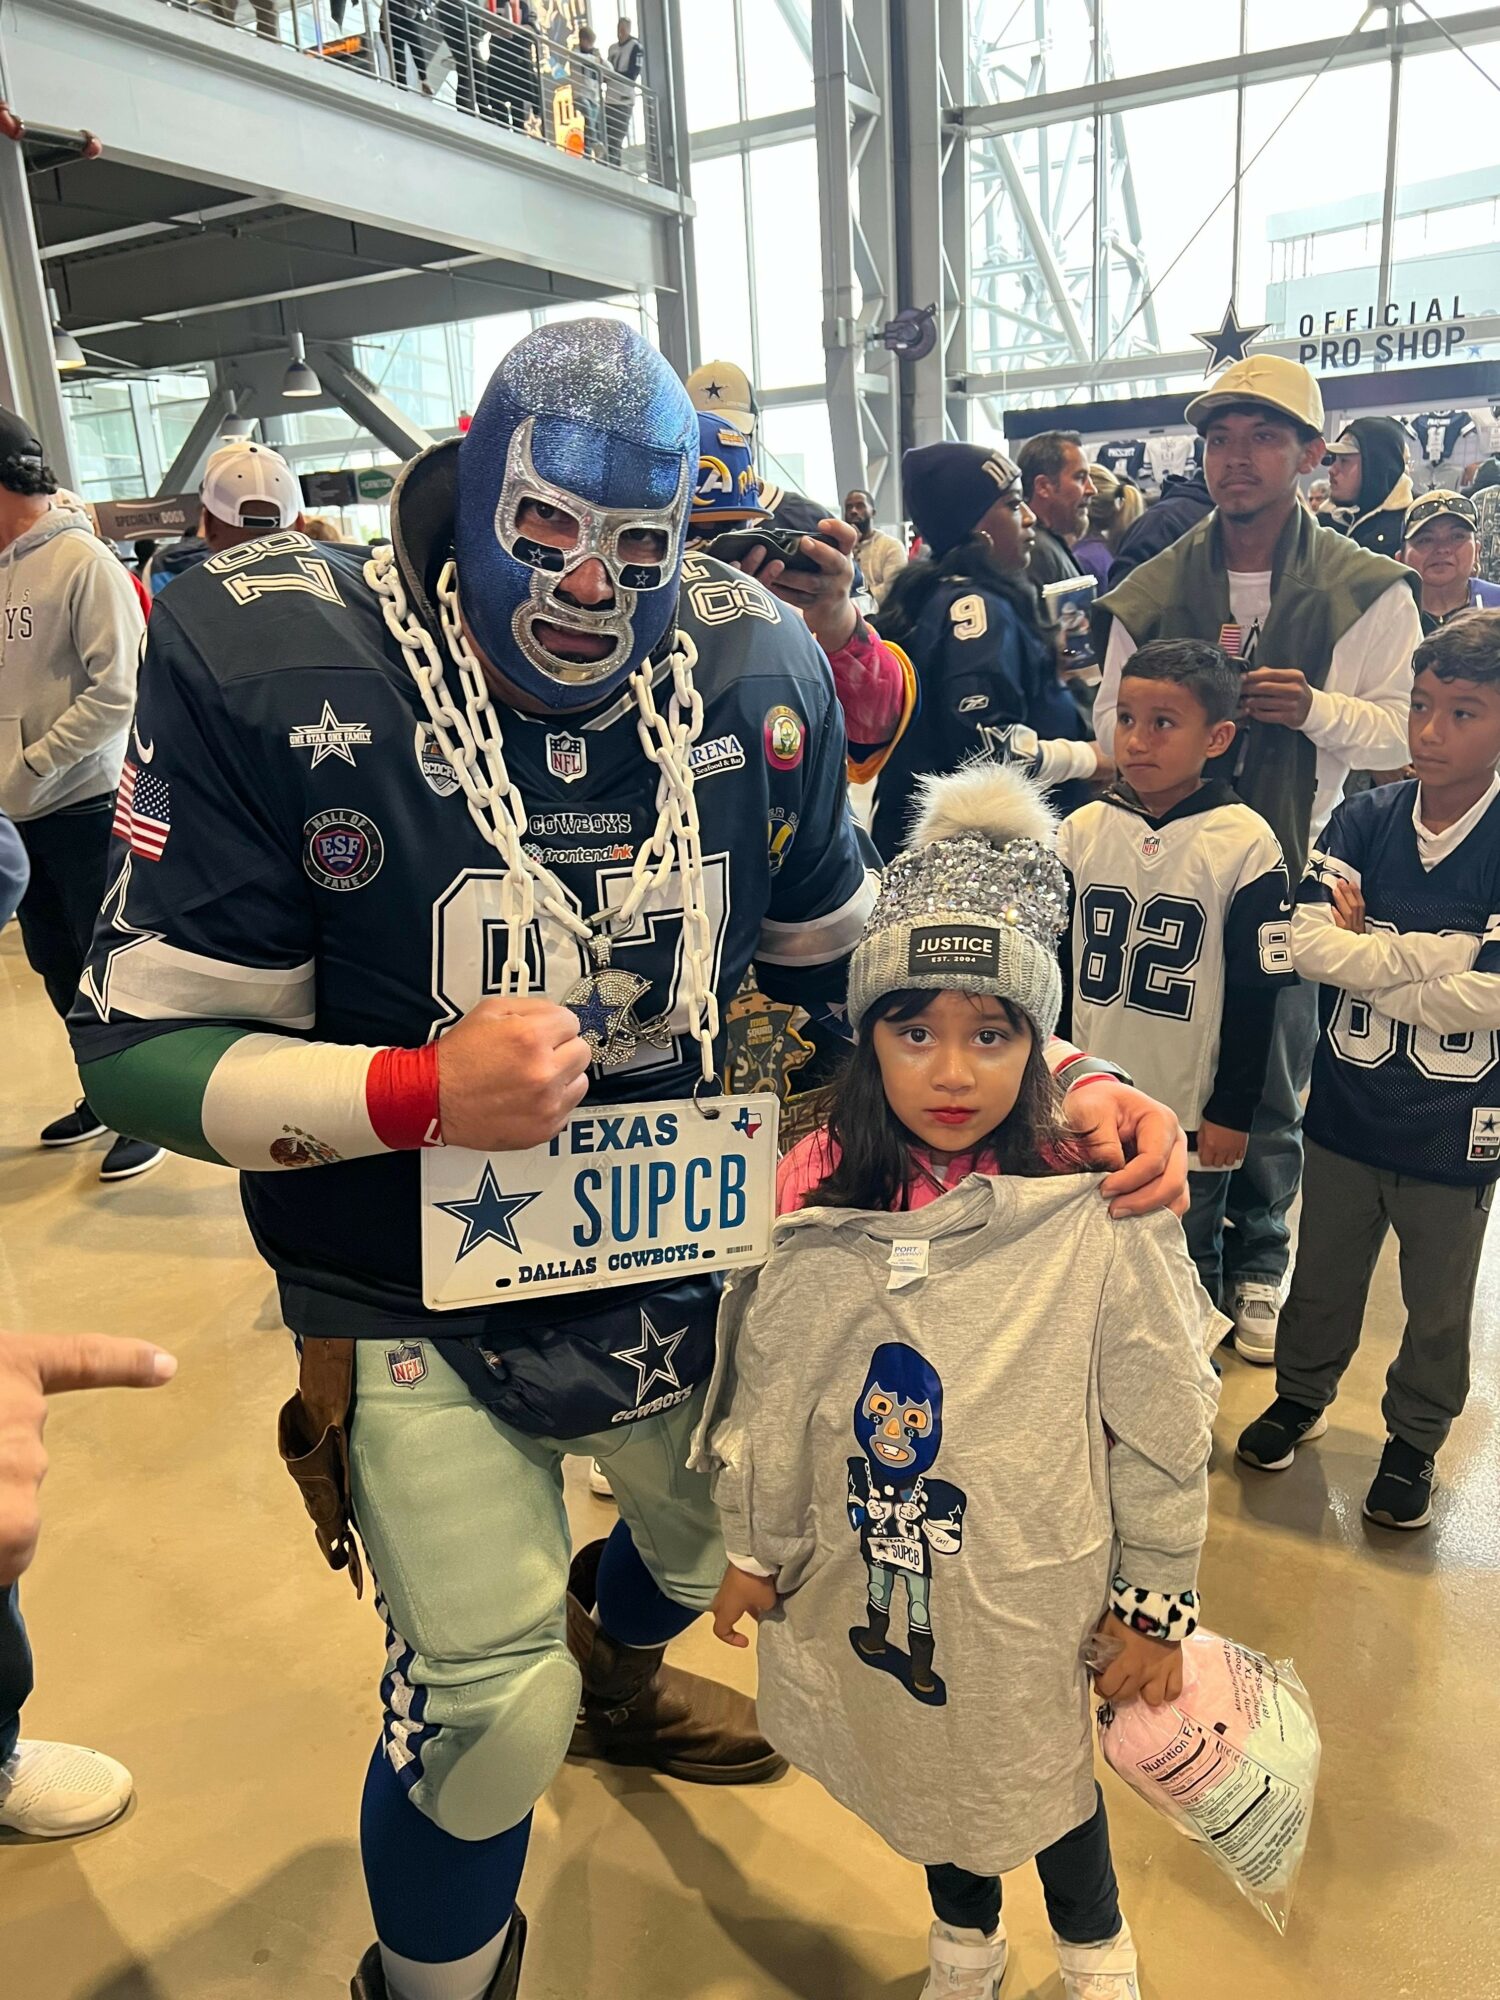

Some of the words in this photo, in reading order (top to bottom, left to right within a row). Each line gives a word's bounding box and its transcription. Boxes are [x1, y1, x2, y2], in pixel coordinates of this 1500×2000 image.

[1300, 295, 1466, 338] OFFICIAL
[1300, 338, 1361, 370] PRO
[1374, 326, 1465, 363] SHOP
[160, 509, 186, 524] DOGS
[950, 594, 988, 641] 9
[289, 735, 305, 745] ONE
[306, 733, 326, 744] STAR
[327, 732, 343, 742] ONE
[344, 731, 371, 742] FAMILY
[553, 752, 581, 774] NFL
[695, 760, 723, 775] Seafood
[730, 757, 742, 766] Bar
[311, 811, 346, 830] HALL
[349, 814, 368, 828] OF
[529, 813, 631, 835] COWBOYS
[320, 835, 360, 857] ESF
[543, 843, 633, 863] frontend.ink
[1143, 843, 1158, 854] NFL
[323, 876, 360, 889] FAME
[916, 936, 993, 953] JUSTICE
[1079, 883, 1207, 1022] 82
[550, 1113, 678, 1157] TEXAS
[572, 1154, 747, 1248] SUPCB
[518, 1257, 597, 1284] DALLAS
[607, 1242, 700, 1272] COWBOYS
[394, 1360, 423, 1380] NFL
[611, 1383, 694, 1424] COWBOYS
[891, 1544, 920, 1566] SUPCB
[1245, 1667, 1253, 1680] TX
[1141, 1739, 1189, 1774] Nutrition
